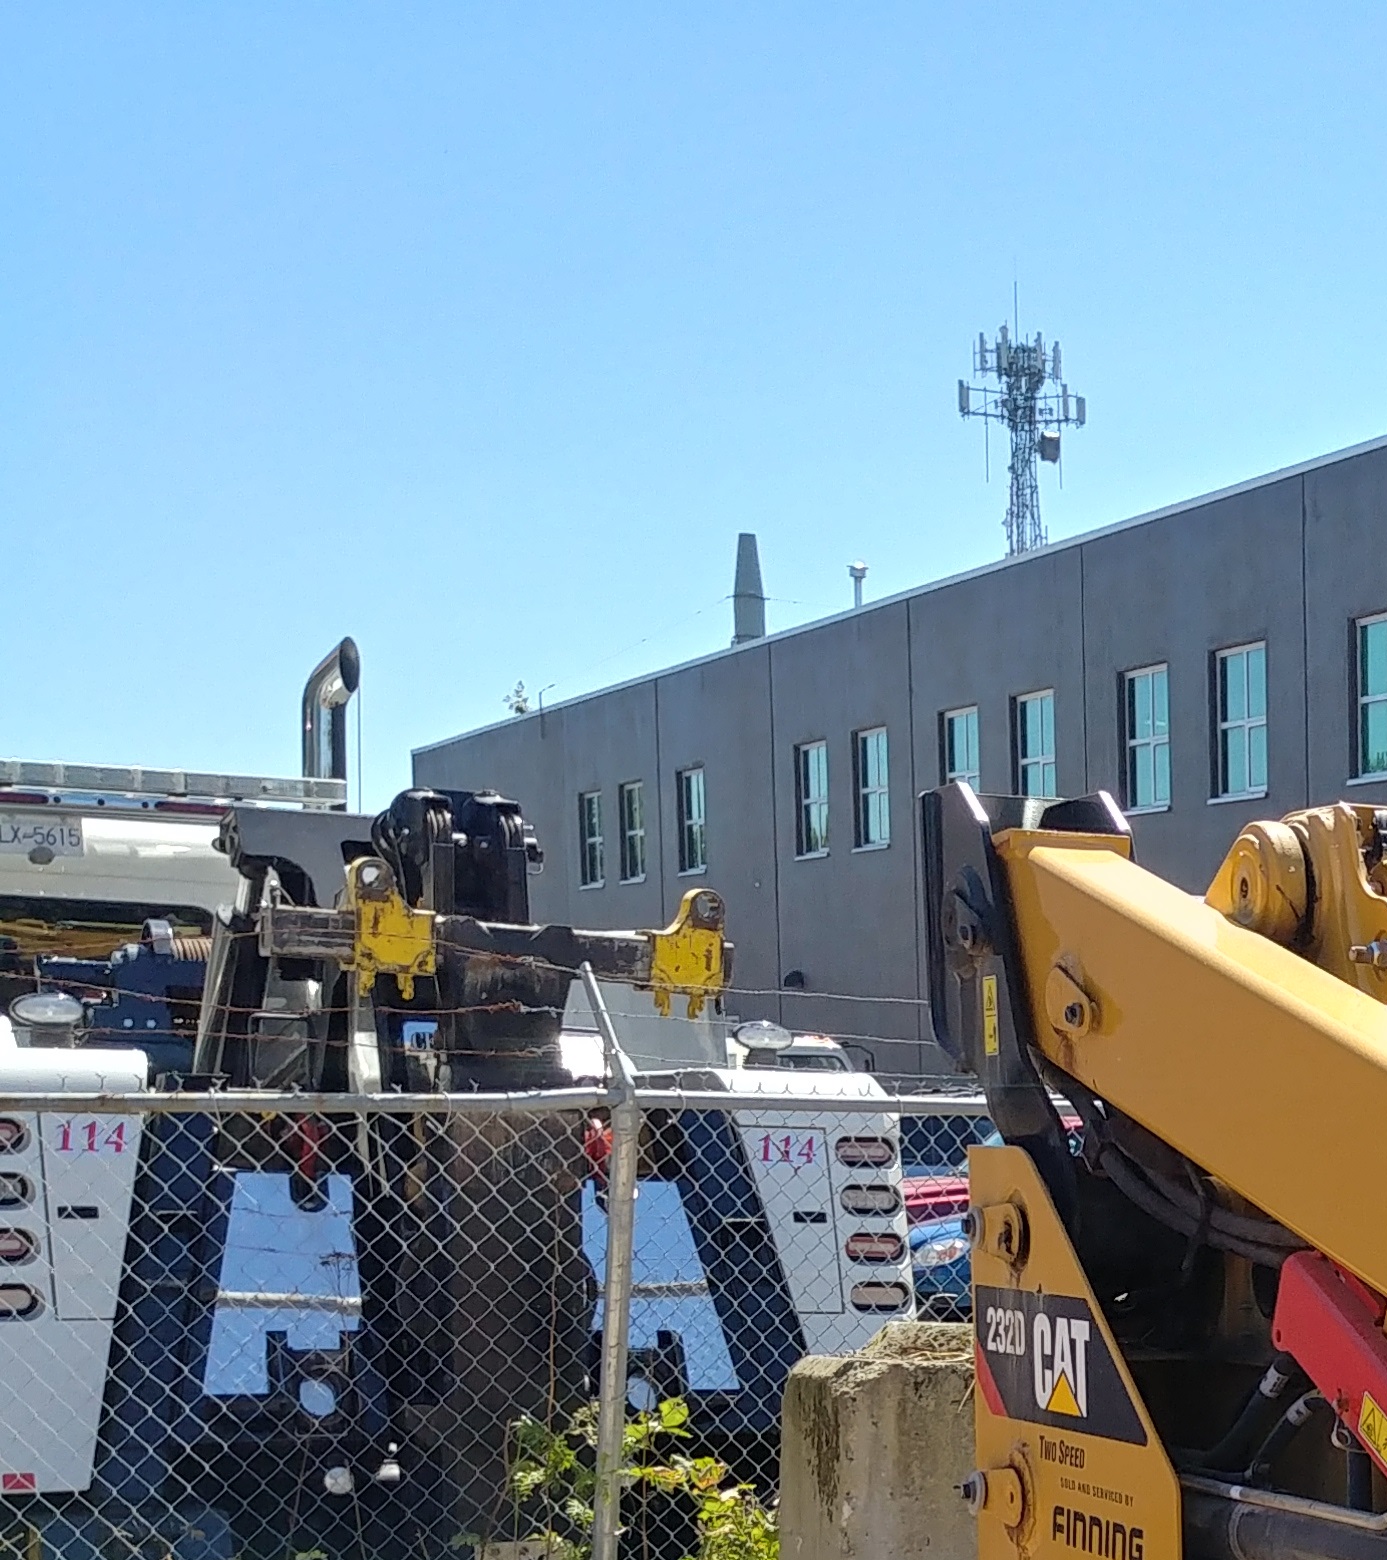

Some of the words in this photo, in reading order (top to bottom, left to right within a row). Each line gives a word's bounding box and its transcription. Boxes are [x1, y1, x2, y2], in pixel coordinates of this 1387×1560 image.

[56, 1120, 128, 1153] 114
[758, 1134, 817, 1164] 114
[986, 1306, 1026, 1356] 232D
[1033, 1312, 1091, 1418] CAT
[1060, 1477, 1076, 1491] SOLD
[1077, 1481, 1091, 1496] AND
[1093, 1485, 1123, 1504] SERVICED
[1124, 1494, 1134, 1507] BY
